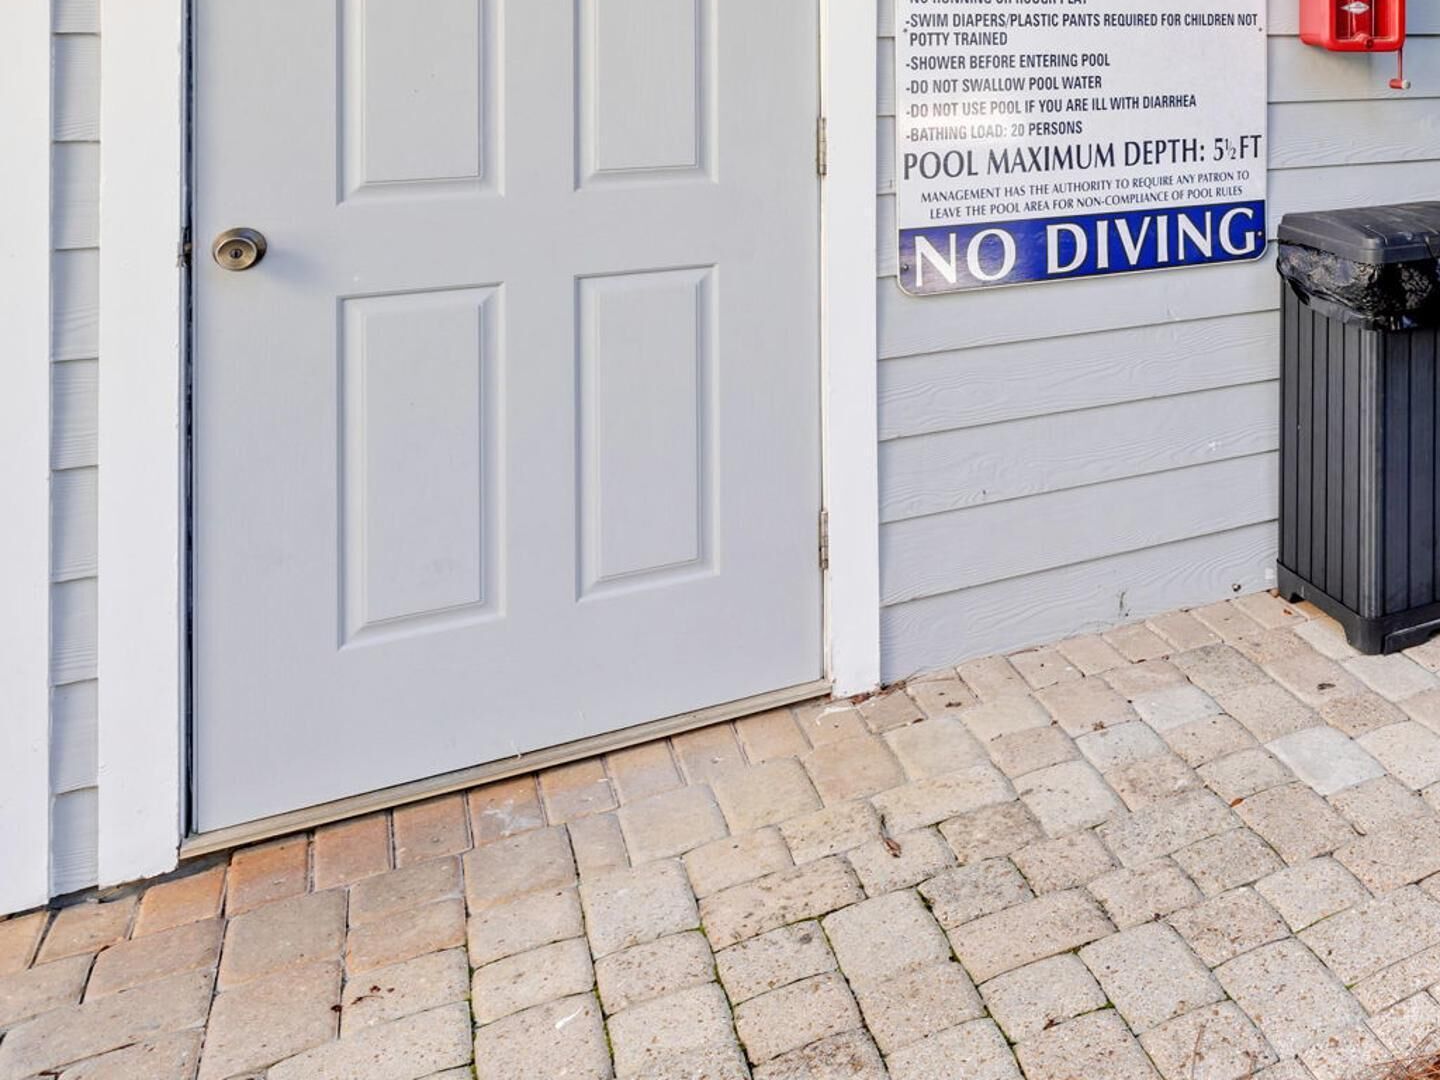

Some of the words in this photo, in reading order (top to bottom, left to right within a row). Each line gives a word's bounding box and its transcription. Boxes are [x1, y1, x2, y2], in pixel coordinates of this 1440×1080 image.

[1062, 13, 1101, 27] PANTS
[1103, 13, 1158, 27] REQUIRED
[1161, 13, 1181, 26] FOR
[1184, 13, 1234, 26] CHILDREN
[1237, 13, 1258, 26] NOT
[910, 32, 950, 47] POTTY
[954, 32, 1008, 46] TRAINED
[969, 55, 1016, 69] BEFORE
[1019, 53, 1078, 69] ENTERING
[1081, 53, 1110, 67] POOL
[932, 79, 959, 93] NOT
[962, 77, 1025, 92] SWALLOW
[1028, 76, 1059, 91] POOL
[1062, 75, 1102, 90] WATER
[932, 102, 959, 117] NOT
[962, 101, 987, 116] USE
[990, 100, 1022, 115] POOL
[1024, 100, 1035, 113] IF
[1038, 99, 1062, 113] YOU
[1066, 98, 1088, 112] ARE
[1092, 97, 1107, 111] ILL
[1110, 96, 1140, 110] WITH
[1142, 94, 1197, 109] DIARRHEA
[970, 124, 1007, 139] LOAD:
[1011, 123, 1025, 137] 20
[1028, 120, 1083, 136] PERSONS
[903, 150, 978, 180] POOL
[987, 142, 1115, 175] MAXIMUM
[1124, 138, 1205, 167] DEPTH:
[920, 187, 1001, 203] MANAGEMENT
[1004, 185, 1026, 197] HAS
[1029, 183, 1050, 196] THE
[1052, 179, 1113, 194] AUTHORITY
[1115, 178, 1130, 190] TO
[1132, 175, 1174, 189] REQUIRE
[1176, 174, 1195, 186] ANY
[1197, 171, 1235, 183] PATRON
[1236, 170, 1250, 181] TO
[930, 206, 962, 219] LEAVE
[966, 205, 986, 217] THE
[990, 202, 1021, 215] POOL
[1024, 200, 1050, 212] AREA
[1052, 198, 1074, 210] FOR
[1077, 190, 1169, 208] NON-COMPLIANCE
[1171, 188, 1184, 201] OF
[1187, 186, 1214, 199] POOL
[1216, 185, 1243, 197] RULES
[914, 228, 1016, 287] NO
[1046, 207, 1255, 274] DIVING
